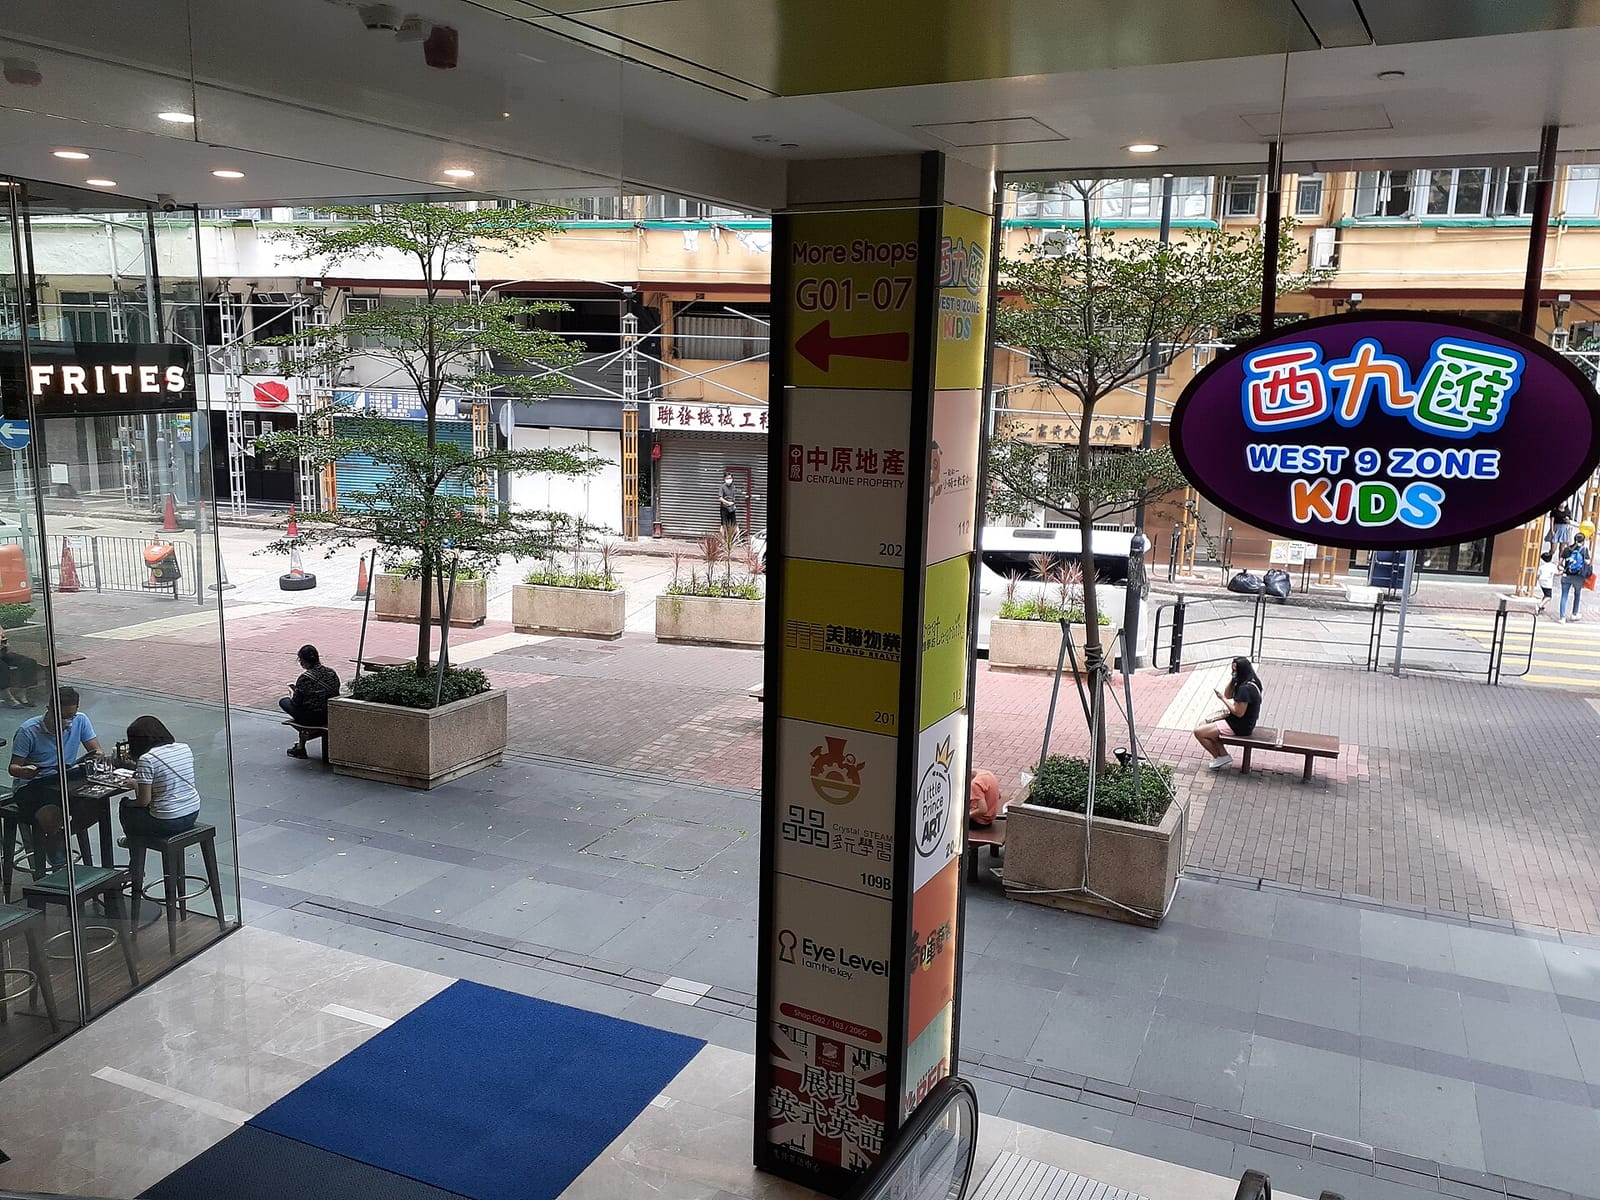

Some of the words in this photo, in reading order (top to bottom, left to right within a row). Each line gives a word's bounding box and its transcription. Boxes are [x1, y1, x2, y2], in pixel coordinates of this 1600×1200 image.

[793, 241, 846, 265] More
[851, 238, 917, 267] Shops
[795, 276, 913, 312] G01-07
[939, 296, 955, 310] EST
[962, 299, 981, 314] ZONE
[943, 315, 972, 341] KIDS
[30, 364, 186, 395] FRITES
[1246, 339, 1523, 435] 西九匯
[807, 446, 905, 476] 中原地產
[1246, 444, 1348, 474] WEST
[1355, 448, 1381, 476] 9
[1389, 447, 1502, 480] ZONE
[806, 474, 855, 486] CENTALINE
[857, 477, 905, 489] PROPERTY
[1290, 477, 1446, 528] KIDS
[879, 543, 904, 557] 202
[826, 624, 901, 653] 美聯物業
[825, 645, 865, 657] MIDLAND
[868, 651, 900, 662] REALTY
[874, 711, 896, 726] 201
[923, 781, 942, 804] Little
[922, 796, 944, 820] Prince
[832, 823, 860, 837] Crystal
[863, 829, 893, 842] STEAM
[921, 808, 944, 847] ART
[860, 872, 892, 891] 109B
[802, 938, 836, 963] Eye
[840, 947, 889, 978] Level
[807, 961, 822, 971] am
[822, 961, 837, 975] the
[794, 1009, 812, 1021] Shop
[800, 1064, 859, 1110] 展現
[769, 1086, 885, 1155] 英式英語
